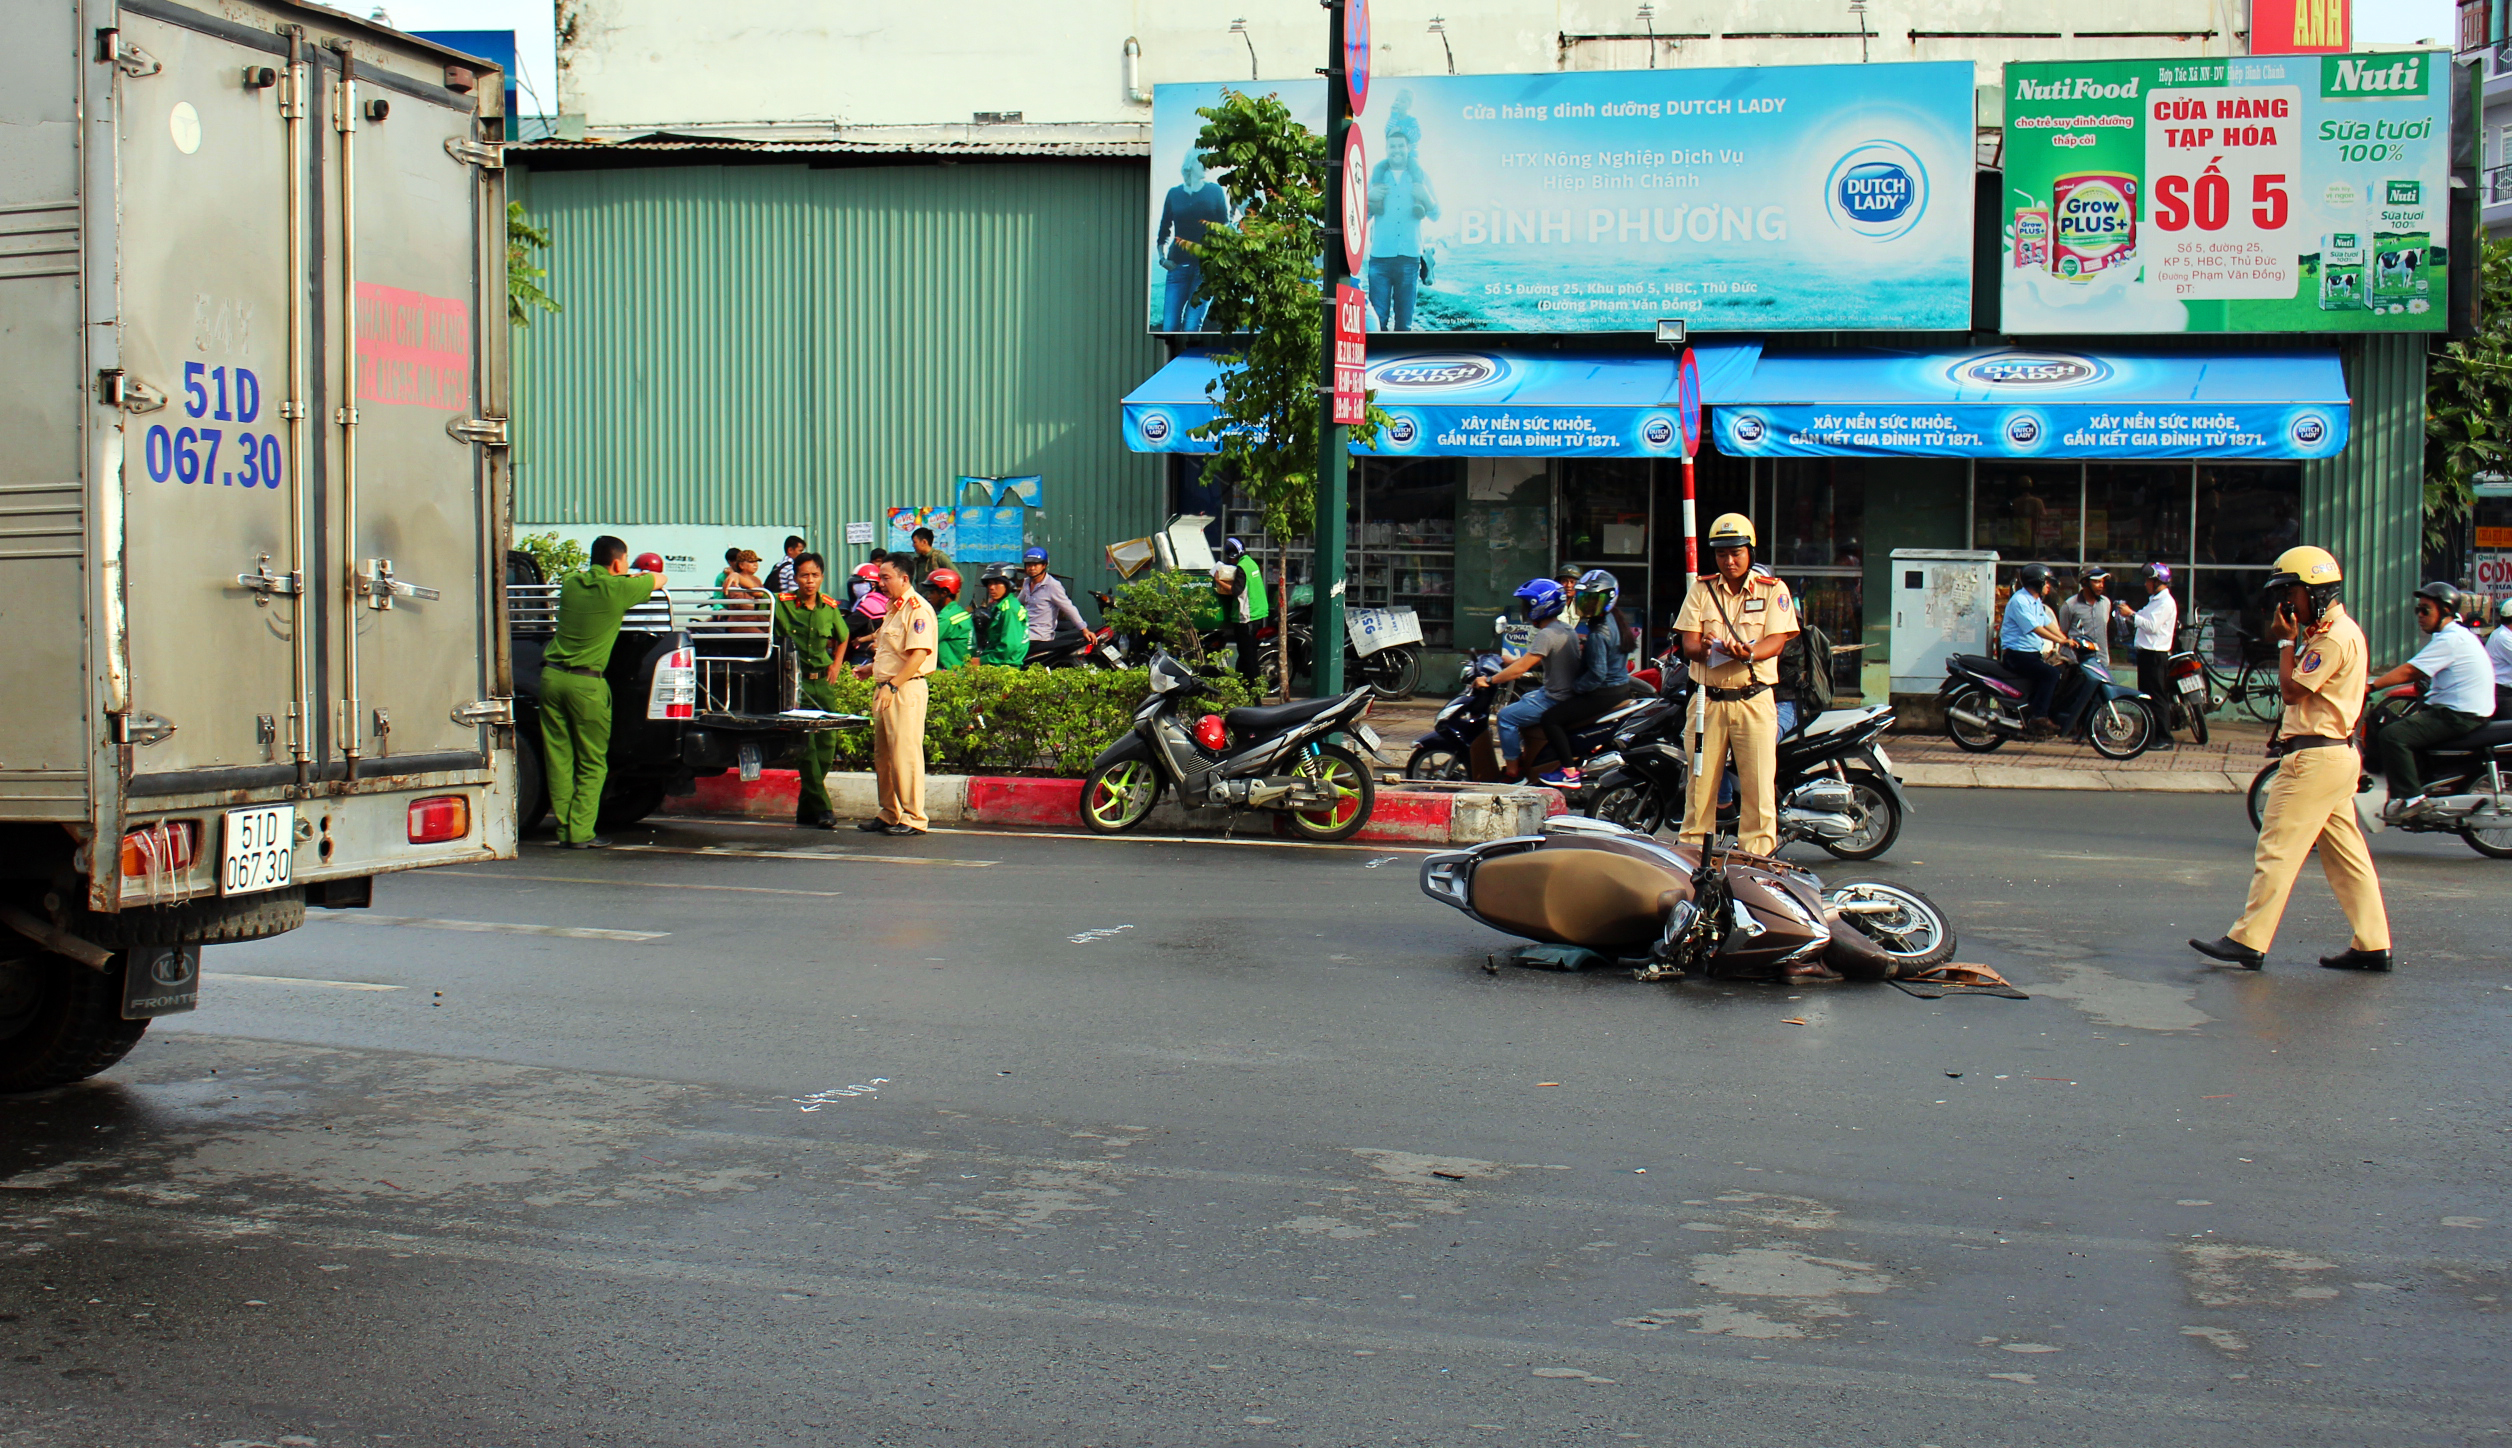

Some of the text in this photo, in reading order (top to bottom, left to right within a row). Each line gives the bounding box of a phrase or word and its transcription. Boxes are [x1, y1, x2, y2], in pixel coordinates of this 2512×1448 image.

[2159, 67, 2173, 86] Hợp
[2174, 67, 2187, 82] Tác
[2245, 65, 2261, 80] Bình
[2263, 63, 2285, 80] Chánh
[2330, 57, 2420, 91] Nuti
[2015, 77, 2139, 100] NutiFood
[1462, 98, 1787, 121] Cửa hàng dinh dưỡng DUTCH LADY
[2154, 96, 2289, 121] CỬA HÀNG
[2016, 116, 2133, 129] cho trẻ suy dinh dưỡng
[2318, 117, 2432, 141] Sữa tươi
[2053, 135, 2095, 147] thấp còi
[2164, 124, 2278, 151] TẠP HÓA
[1501, 149, 1744, 169] HTX Nông Nghiệp Dịch Vụ
[2338, 143, 2405, 162] 100%
[1543, 173, 1700, 192] Hiệp Bình Chánh
[1848, 178, 1906, 194] DUTCH
[1854, 195, 1899, 210] LADY
[2155, 156, 2289, 232] SỐ 5
[2389, 189, 2418, 202] Nuti
[2066, 198, 2120, 215] Grow
[1460, 201, 1787, 244] BÌNH PHƯƠNG
[2060, 216, 2128, 233] PLUS+
[2390, 221, 2416, 229] 100%
[2177, 242, 2263, 255] Số 5, đường 25,
[2335, 238, 2354, 247] Nuti
[2164, 256, 2277, 267] KP 5, HBC, Thủ Đức
[2158, 268, 2286, 282] (Đường Phạm Văn Đồng)
[1485, 281, 1758, 297] Số 5 Đường 25, Khu phố 5, HBC, Thủ Đức
[2176, 284, 2195, 294] ĐT:
[1342, 290, 1361, 333] CẤM
[1538, 298, 1703, 313] (Đường Phạm Văn Đồng)
[356, 288, 465, 356] NHẬN CHỞ HÀNG
[1391, 361, 1479, 376] DUTCH
[1395, 372, 1464, 383] LADY
[1984, 365, 2077, 375] DUTCH
[1994, 372, 2062, 381] LADY
[184, 361, 260, 424] 51D
[1461, 413, 1597, 433] XÂY NỀN SỨC KHỎE,
[1813, 412, 1958, 431] XÂY NỀN SỨC KHỎE,
[2090, 411, 2240, 431] XÂY NỀN SỨC KHỎE,
[1437, 430, 1621, 448] GẮN KẾT GIA ĐÌNH TỪ 1871.
[1789, 430, 1983, 446] GẮN KẾT GIA ĐÌNH TỪ 1871.
[2063, 429, 2267, 446] GẮN KẾT GIA ĐÌNH TỪ 1871.
[146, 424, 282, 490] 067.30
[242, 812, 278, 849] 51D
[226, 848, 290, 891] 067.30
